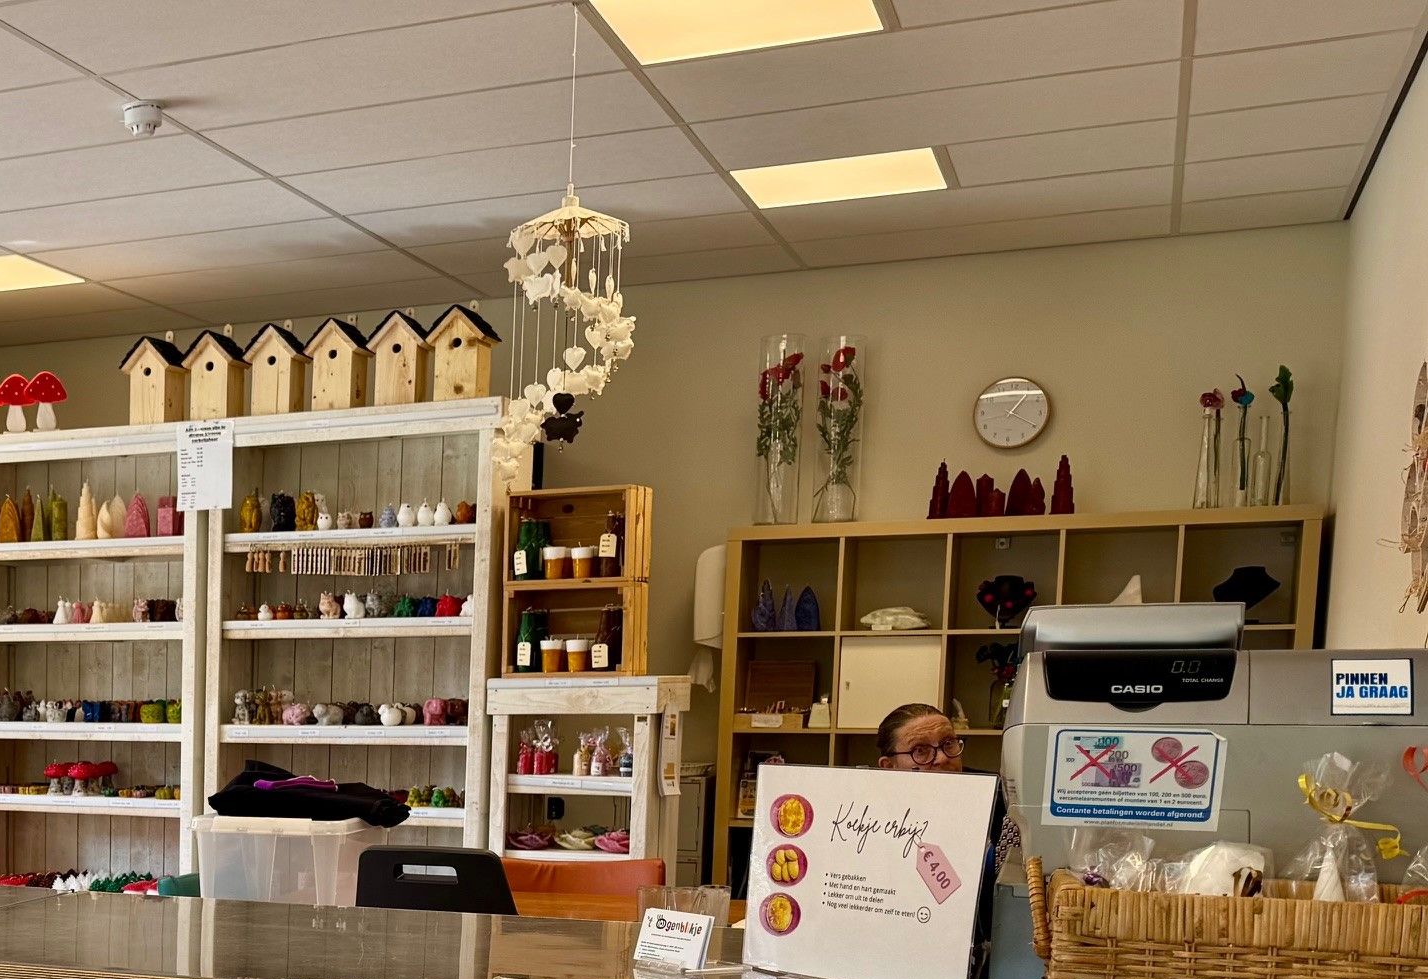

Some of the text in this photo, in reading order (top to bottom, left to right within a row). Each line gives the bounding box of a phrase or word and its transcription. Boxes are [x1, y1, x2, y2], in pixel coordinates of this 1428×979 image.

[1336, 673, 1388, 685] PINNEN
[1111, 684, 1164, 694] CASIO
[1336, 686, 1408, 698] JA GRAAG
[1056, 806, 1091, 814] Contante
[1092, 808, 1134, 817] betalingen
[1167, 810, 1205, 818] afgerond.
[830, 801, 928, 858] Koekje erbij?
[923, 851, 951, 890] € 4,00
[841, 873, 867, 881] gebakken
[873, 887, 896, 895] gemaakt
[827, 900, 837, 909] Nog
[849, 903, 874, 912] lekkerder
[884, 907, 894, 915] zelf
